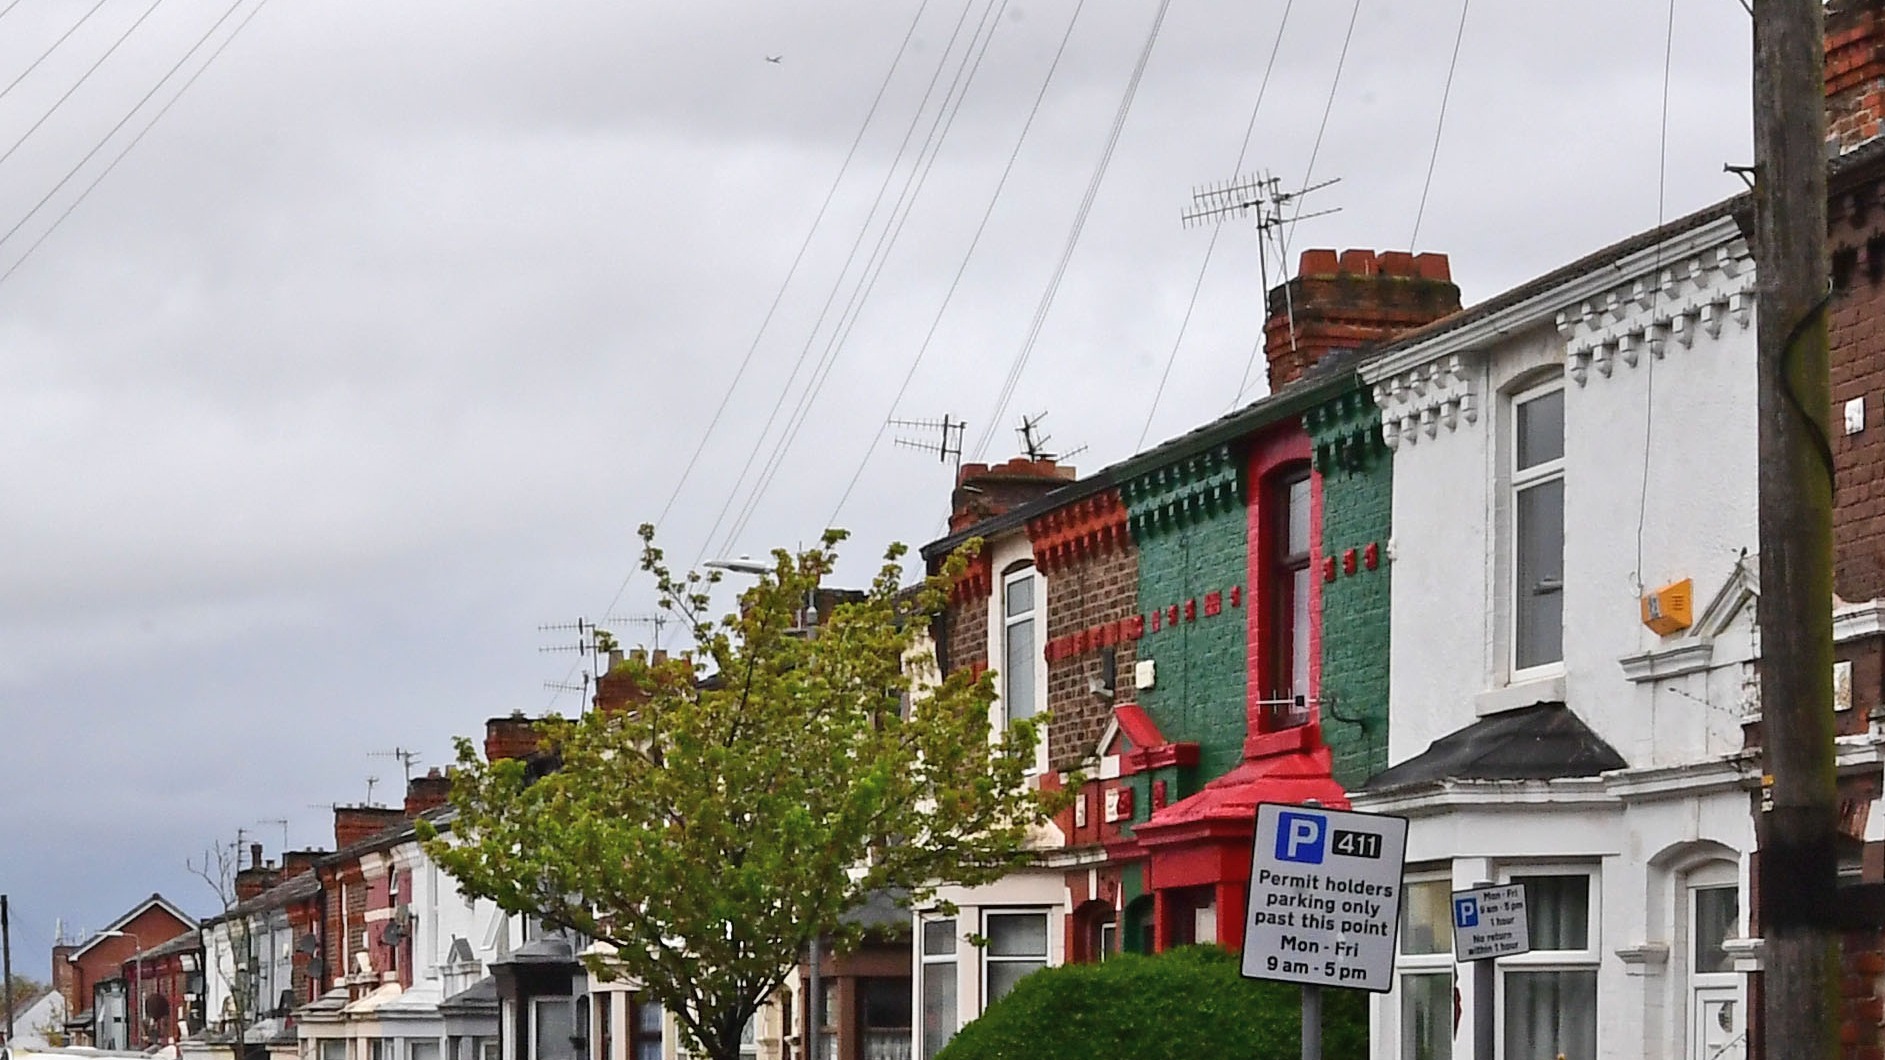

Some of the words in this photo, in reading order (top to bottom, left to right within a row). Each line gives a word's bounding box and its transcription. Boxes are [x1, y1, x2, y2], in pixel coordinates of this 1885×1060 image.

[1287, 817, 1319, 858] P
[1337, 833, 1377, 857] 411
[1259, 869, 1319, 890] Permit
[1325, 876, 1393, 898] holders
[1266, 892, 1336, 914] parking
[1342, 900, 1381, 918] only
[1461, 902, 1474, 925] P
[1255, 911, 1295, 926] past
[1302, 913, 1335, 930] this
[1341, 919, 1388, 936] point
[1280, 935, 1319, 953] Mon
[1335, 941, 1359, 957] Fri
[1282, 961, 1309, 974] am
[1339, 967, 1367, 981] pm
